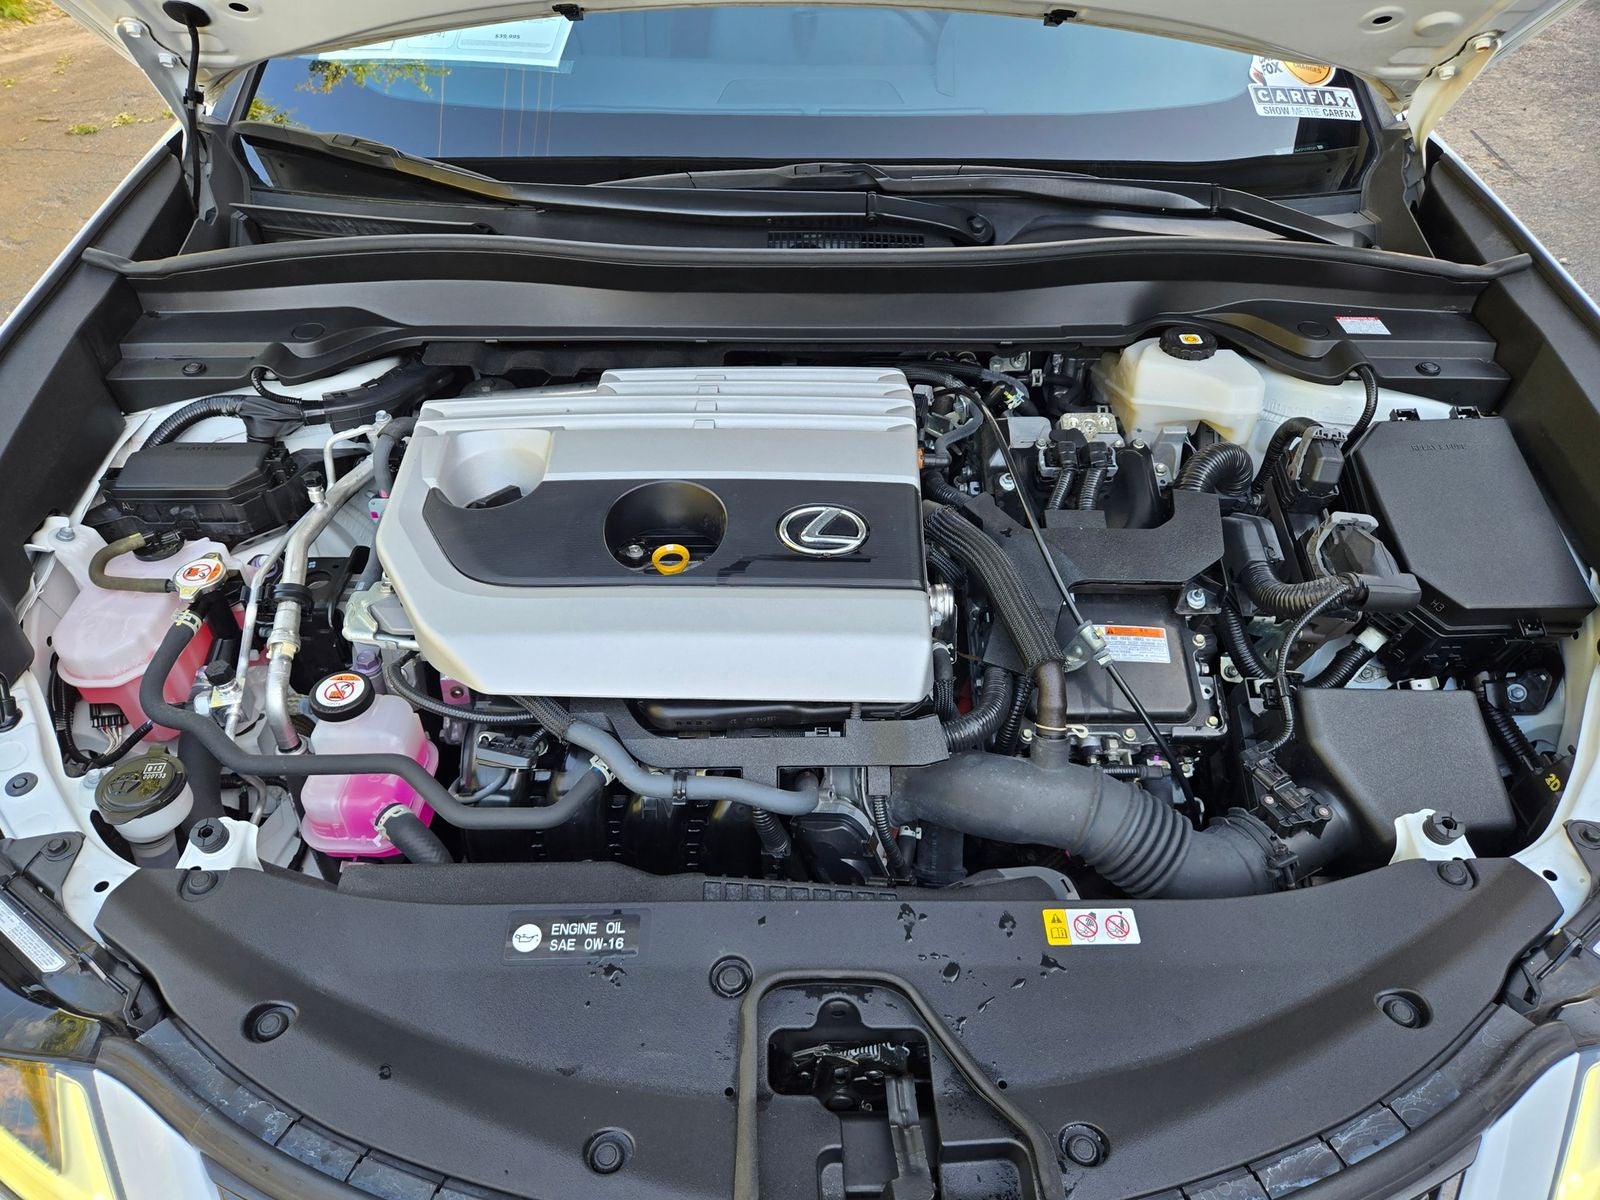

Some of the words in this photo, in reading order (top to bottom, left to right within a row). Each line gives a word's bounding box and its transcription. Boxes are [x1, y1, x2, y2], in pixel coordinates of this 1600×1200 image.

[1262, 62, 1283, 74] FOX
[1257, 89, 1352, 107] CARFAX
[1263, 106, 1290, 115] SHOW
[1291, 107, 1304, 115] ME
[1305, 107, 1322, 116] THE
[1322, 108, 1356, 118] CARFAX
[641, 797, 675, 819] HV
[551, 922, 598, 936] ENGINE
[605, 921, 626, 934] OIL
[549, 938, 577, 952] SAE
[584, 937, 625, 951] 0W-16
